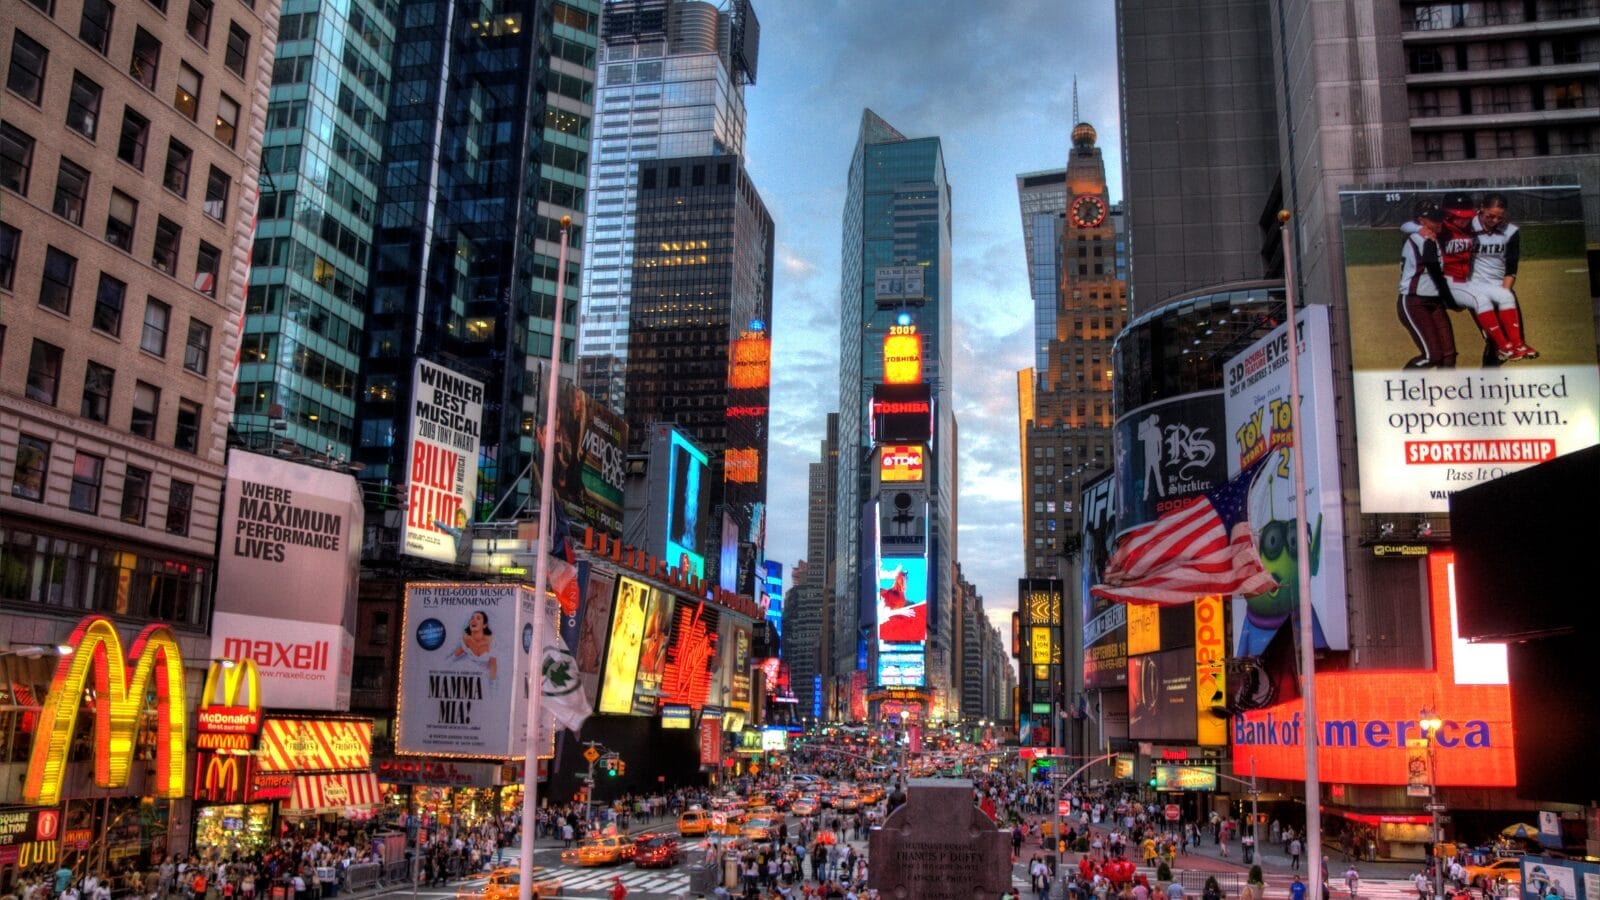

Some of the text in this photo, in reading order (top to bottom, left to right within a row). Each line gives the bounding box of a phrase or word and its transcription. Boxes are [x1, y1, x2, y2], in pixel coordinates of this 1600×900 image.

[1386, 192, 1400, 202] 215
[889, 325, 916, 335] 2009
[886, 355, 920, 363] TOSHIBA
[1229, 319, 1305, 386] 3D EVET
[420, 363, 482, 405] WINNER
[1385, 374, 1568, 407] Helped injured
[433, 389, 467, 415] BEST
[875, 402, 929, 413] TOSHIBA
[416, 400, 479, 437] MUSICAL
[1236, 405, 1264, 454] TOY
[1389, 403, 1568, 434] opponent win.
[419, 420, 436, 440] 2009
[437, 426, 452, 445] TONY
[1271, 432, 1293, 445] STOR
[581, 428, 622, 471] MELROSE
[892, 456, 920, 465] TDK
[1277, 445, 1291, 479] 2
[1409, 441, 1552, 462] SPORTSMANSHIP
[412, 440, 458, 492] BILLY
[601, 463, 625, 492] PLACE
[1446, 468, 1473, 481] Pass
[1477, 468, 1487, 480] It
[241, 480, 292, 505] WHERE
[238, 497, 341, 535] MAXIMUM
[408, 484, 463, 535] ELLIOT
[236, 520, 340, 551] PERFORMANCE
[881, 536, 924, 544] CHEVROLET
[234, 537, 285, 563] LIVES
[424, 597, 431, 605] IS
[433, 597, 439, 605] A
[434, 587, 477, 596] FEEL-GOOD
[480, 587, 514, 596] MUSICAL
[223, 637, 329, 671] maxell
[428, 675, 483, 700] MAMMA
[200, 713, 256, 725] McDonald's
[438, 701, 472, 724] MIA!
[207, 723, 246, 731] Restaurant
[1234, 712, 1491, 748] Bank of merca
[897, 851, 938, 861] FRANCIS
[950, 852, 985, 862] DUFFY
